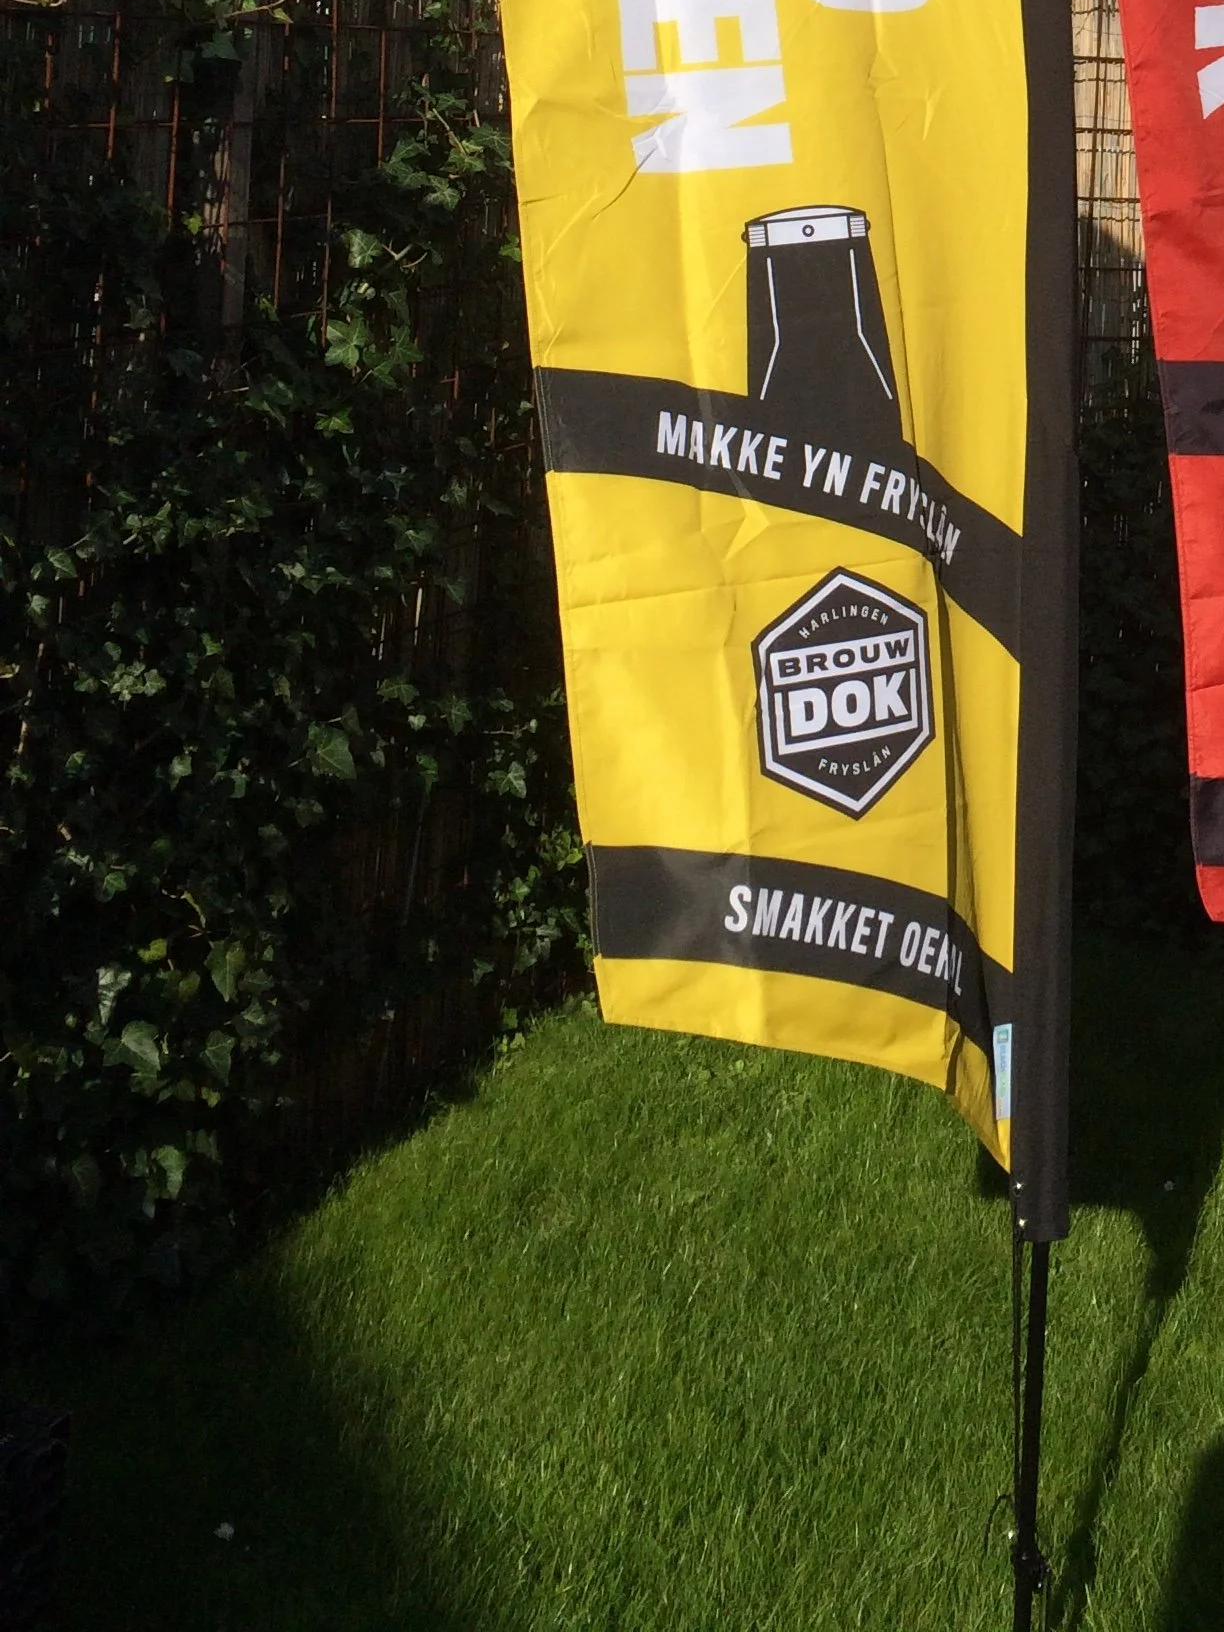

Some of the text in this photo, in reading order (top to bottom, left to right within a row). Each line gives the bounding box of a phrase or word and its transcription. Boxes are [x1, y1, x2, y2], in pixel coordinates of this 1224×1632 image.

[656, 410, 788, 481] MAKKE
[801, 443, 853, 497] YN
[798, 604, 889, 640] HARLINGEN
[777, 637, 910, 679] BROUW
[787, 670, 909, 738] DOK
[724, 884, 895, 959] SMAKKET
